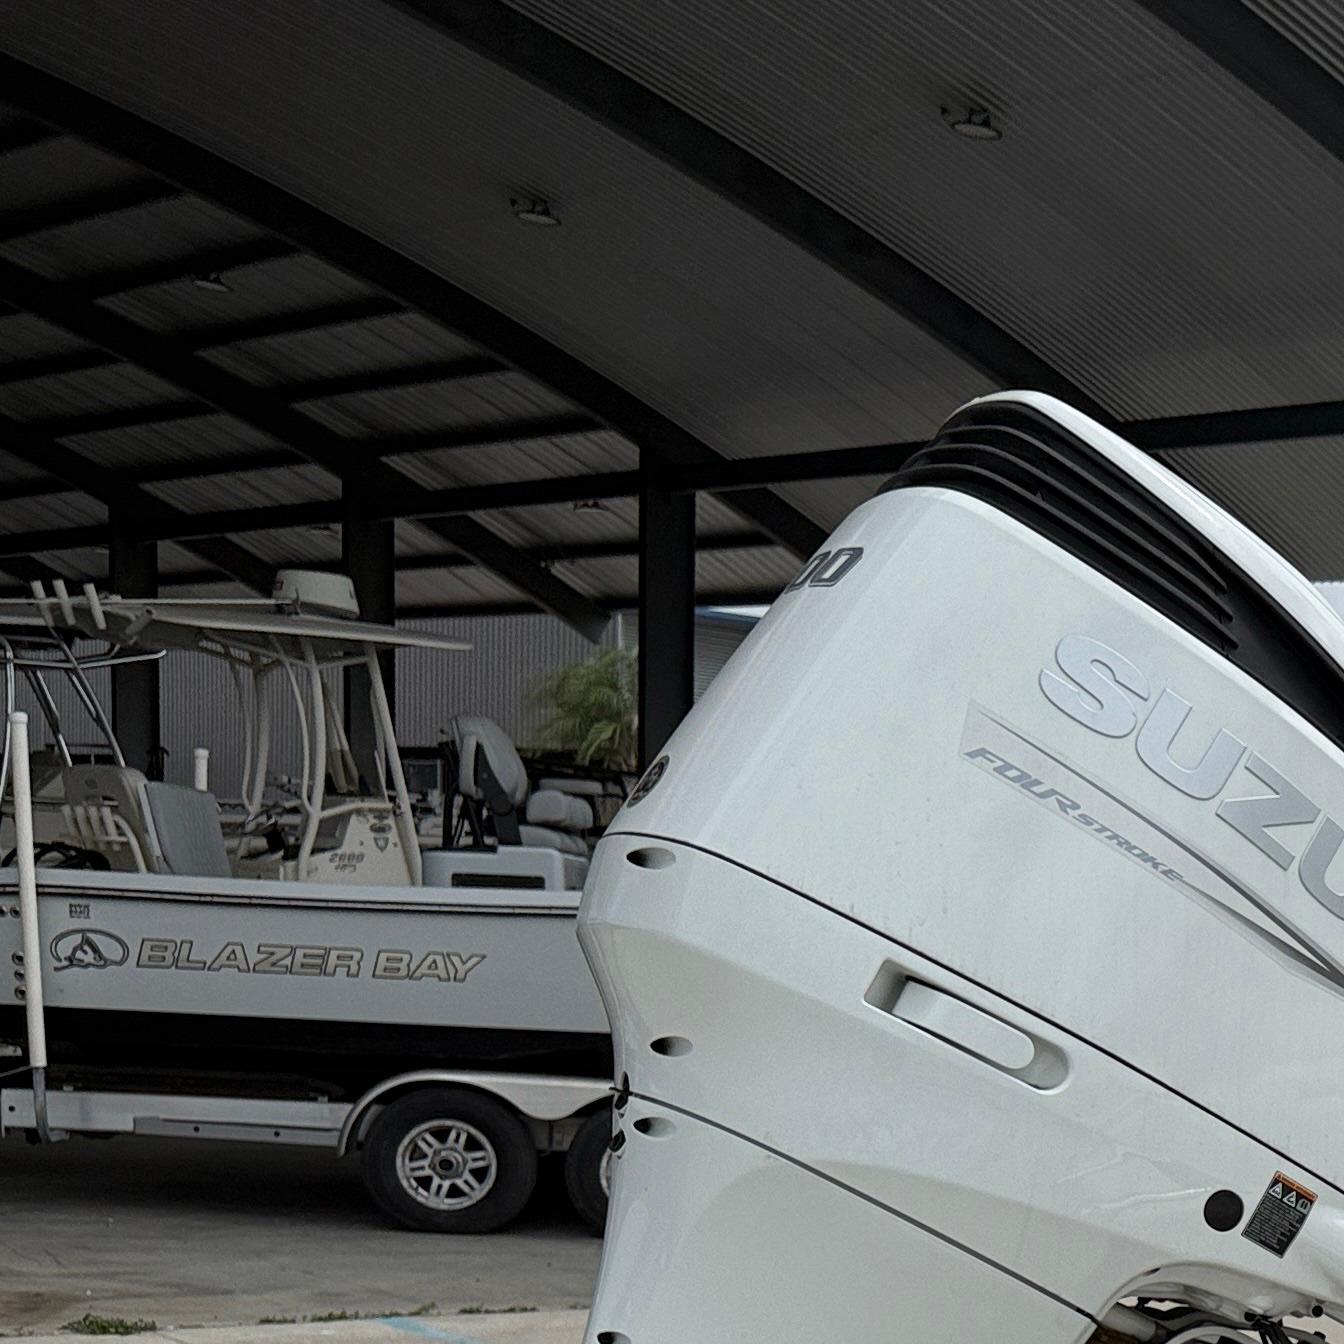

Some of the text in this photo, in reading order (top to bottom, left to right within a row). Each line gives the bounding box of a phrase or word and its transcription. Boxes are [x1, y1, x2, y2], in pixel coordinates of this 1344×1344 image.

[963, 747, 1184, 882] FOUR STROKE
[136, 937, 487, 983] BLAZER BAY
